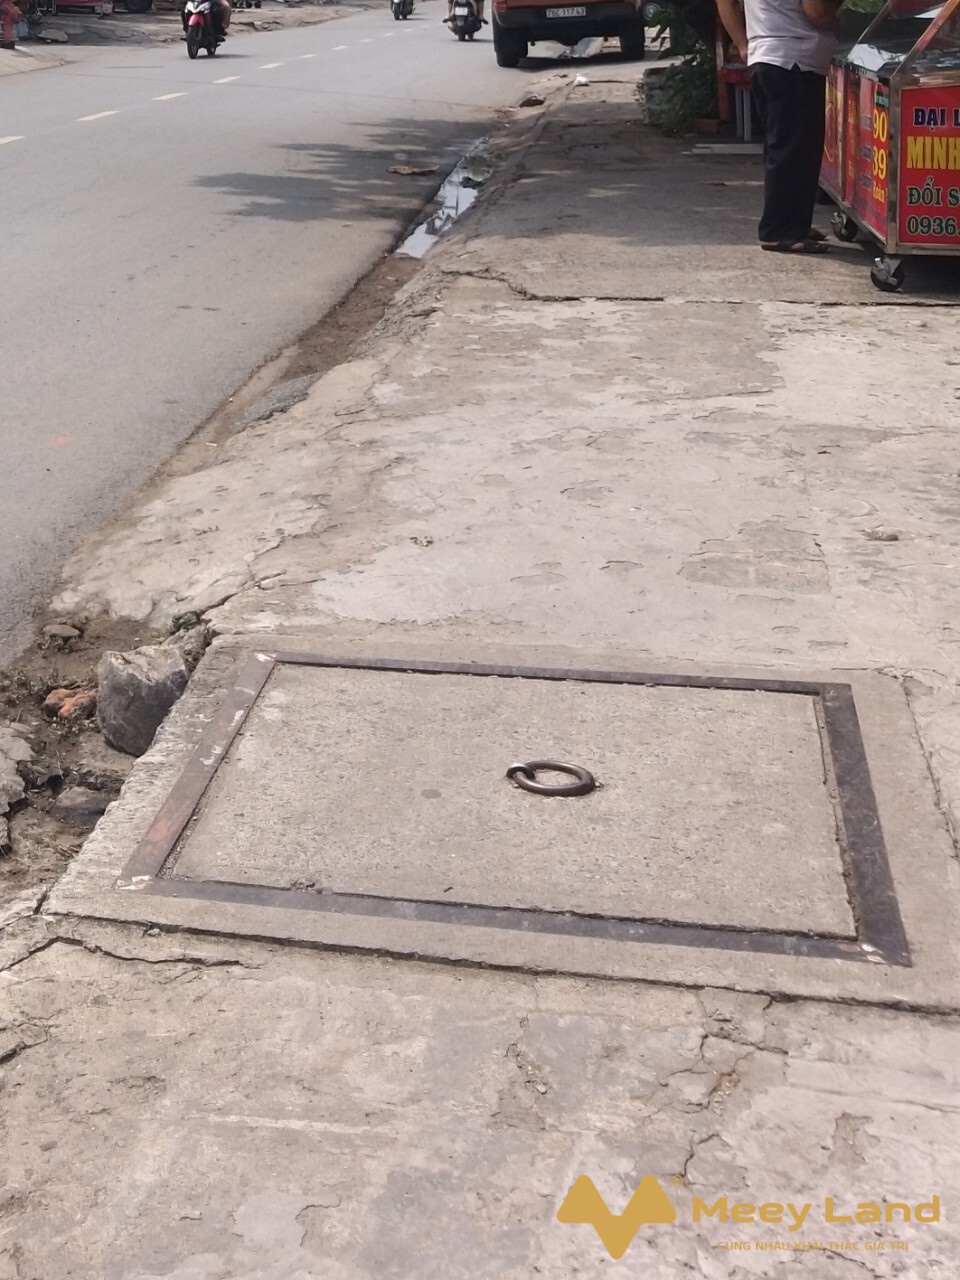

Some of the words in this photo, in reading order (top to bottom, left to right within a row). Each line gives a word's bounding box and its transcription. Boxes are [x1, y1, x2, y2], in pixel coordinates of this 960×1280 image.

[873, 107, 888, 143] 90
[913, 107, 947, 132] ĐẠI
[907, 174, 943, 207] ĐỔI
[947, 186, 960, 208] S
